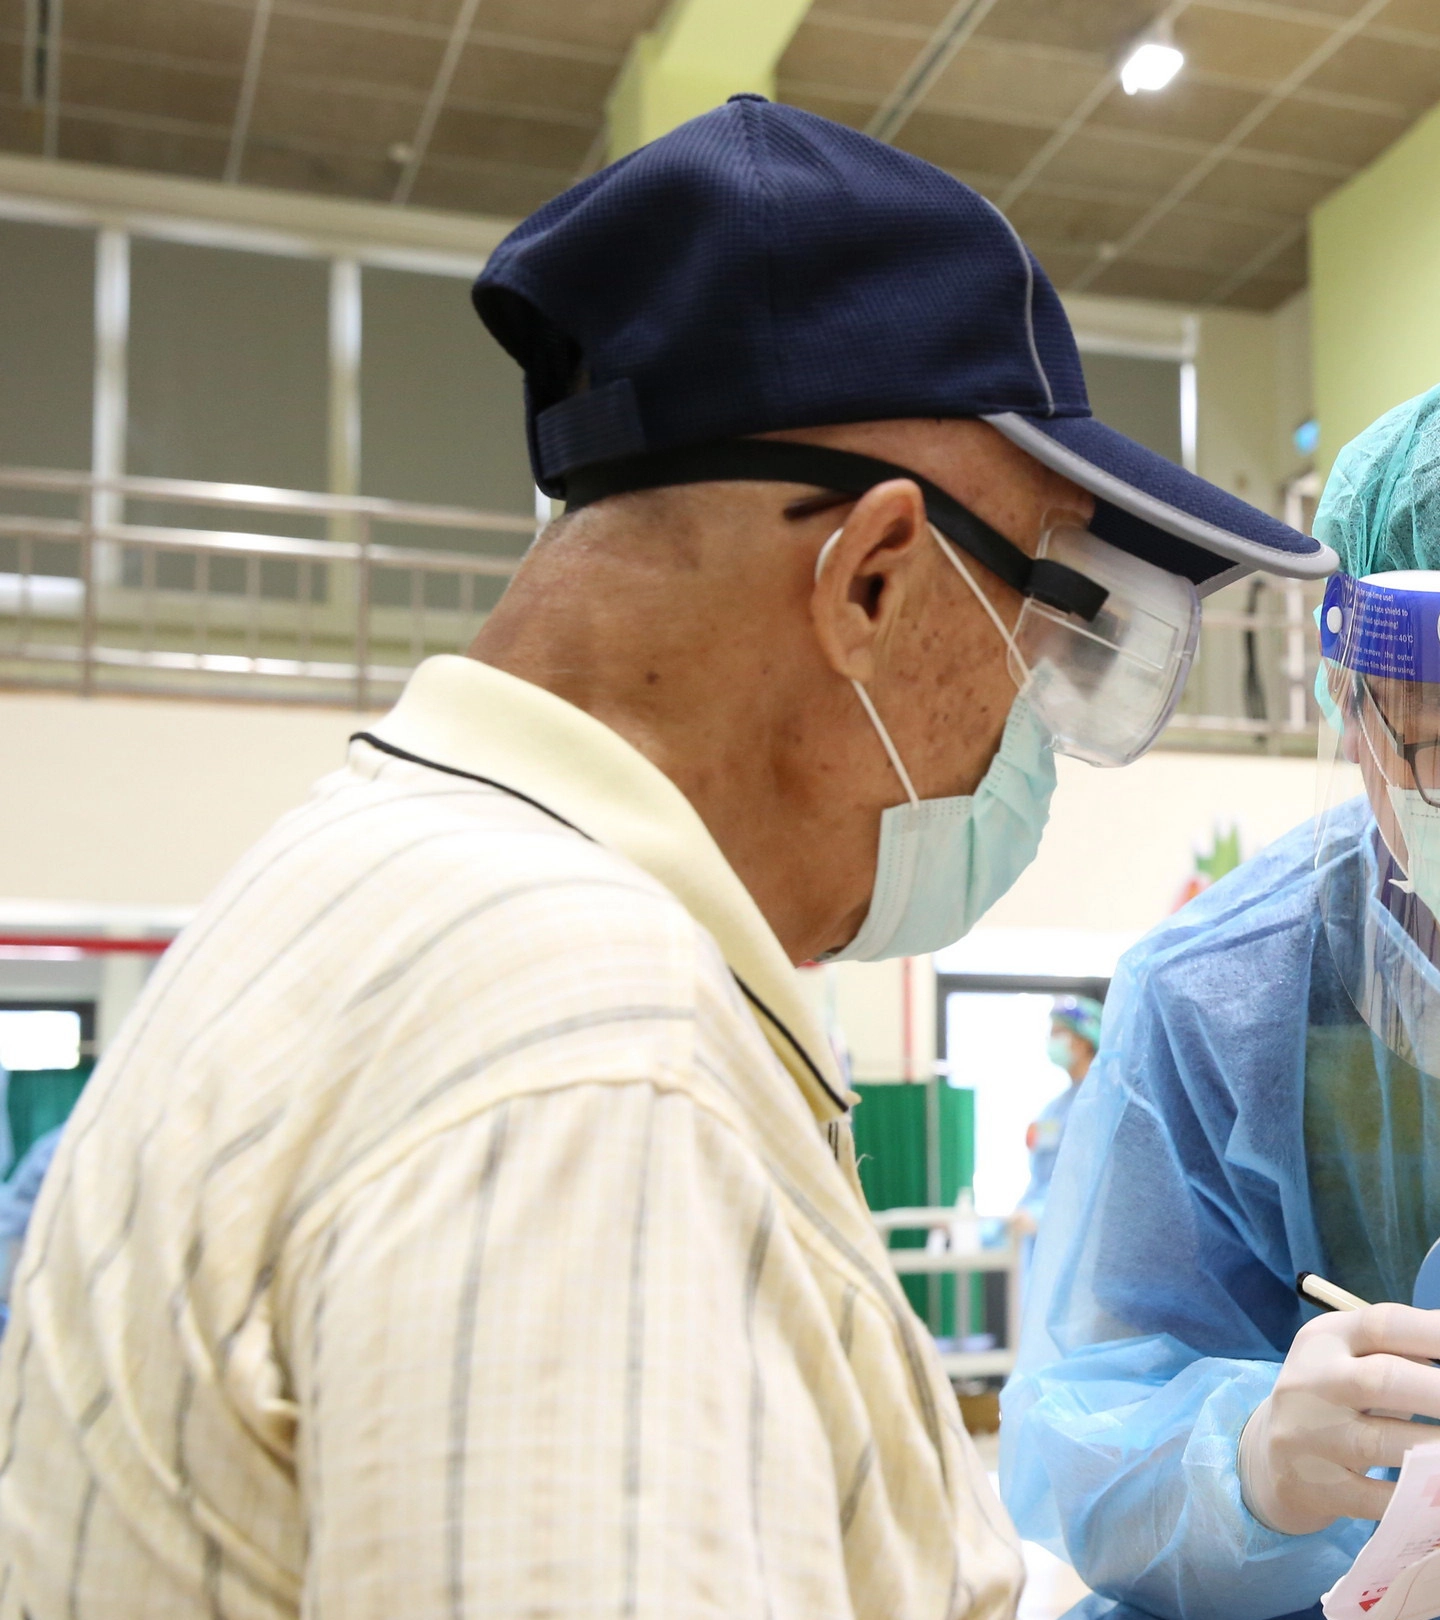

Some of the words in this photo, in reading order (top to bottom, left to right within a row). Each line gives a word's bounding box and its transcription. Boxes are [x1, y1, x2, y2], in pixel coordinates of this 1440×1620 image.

[1384, 606, 1401, 616] shield
[1401, 608, 1409, 617] to
[1384, 650, 1394, 660] the
[1396, 653, 1414, 662] outer
[1379, 662, 1398, 673] before
